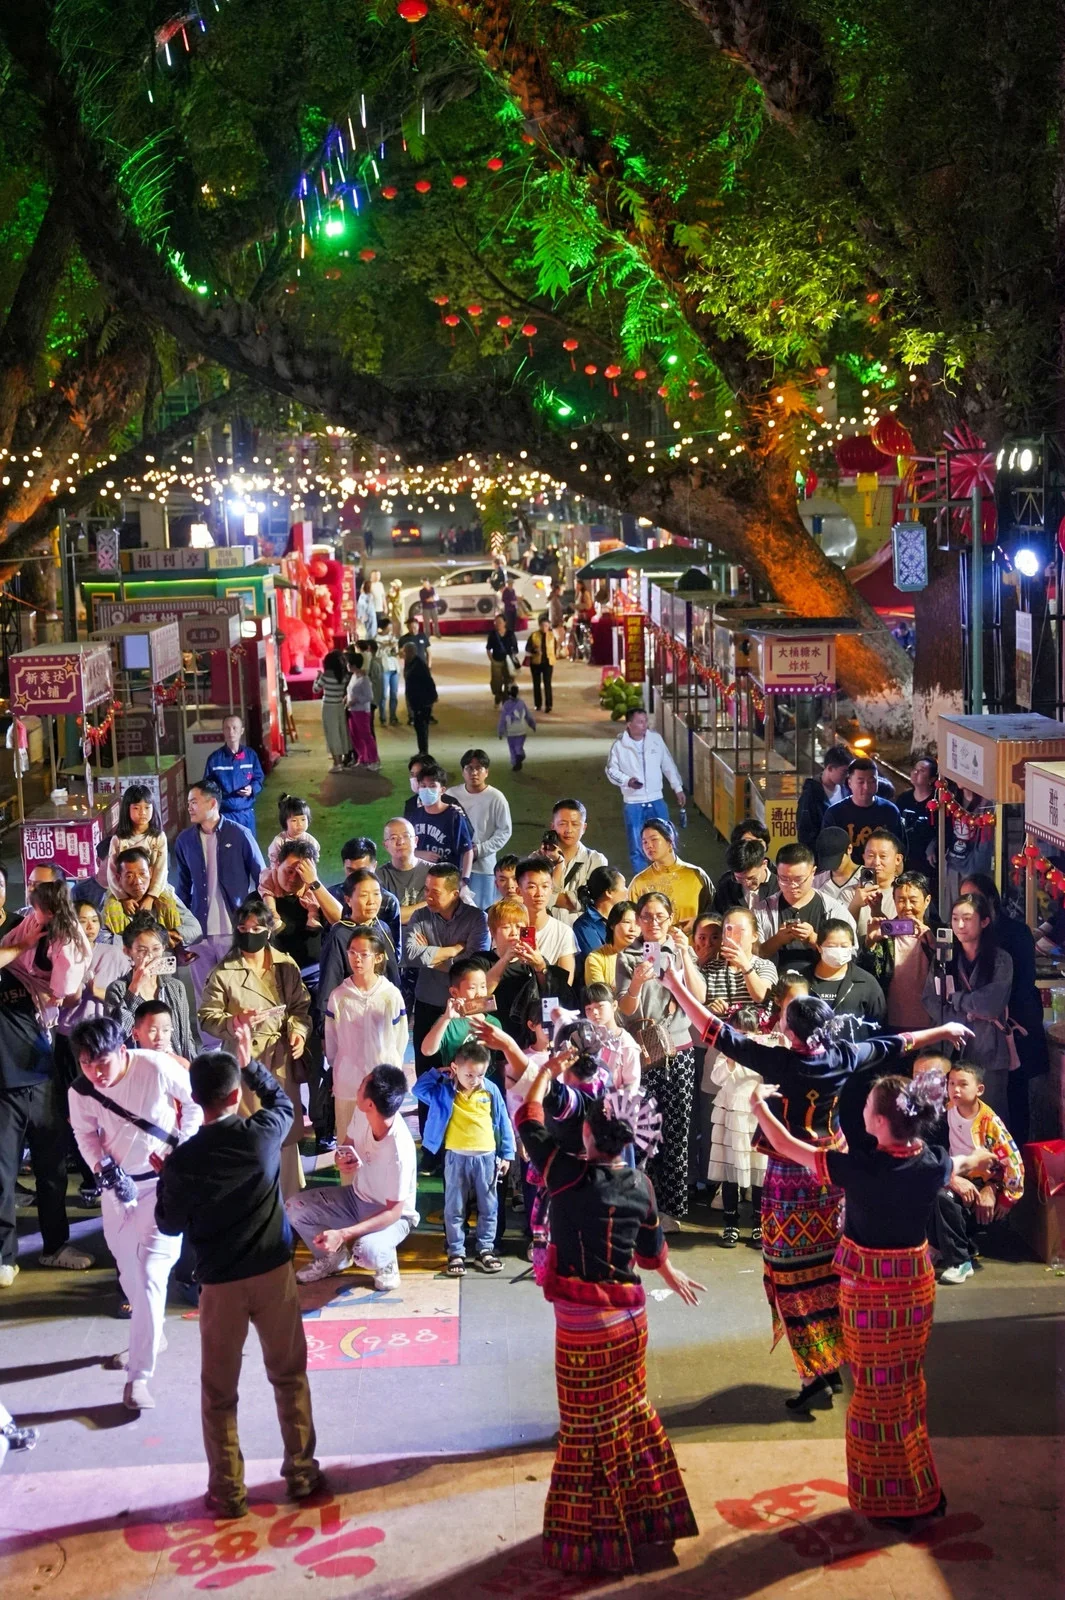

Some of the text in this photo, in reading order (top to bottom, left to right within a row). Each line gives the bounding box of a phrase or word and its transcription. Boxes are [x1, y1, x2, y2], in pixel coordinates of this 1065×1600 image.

[138, 553, 199, 568] 报刊亭
[778, 646, 821, 658] 大桶糖水
[788, 660, 810, 672] 炸炸
[34, 686, 59, 698] 小铺
[771, 807, 796, 821] 通什
[26, 827, 52, 841] 通什
[427, 824, 447, 845] YORK
[771, 821, 796, 837] 1988
[26, 841, 53, 858] 1988
